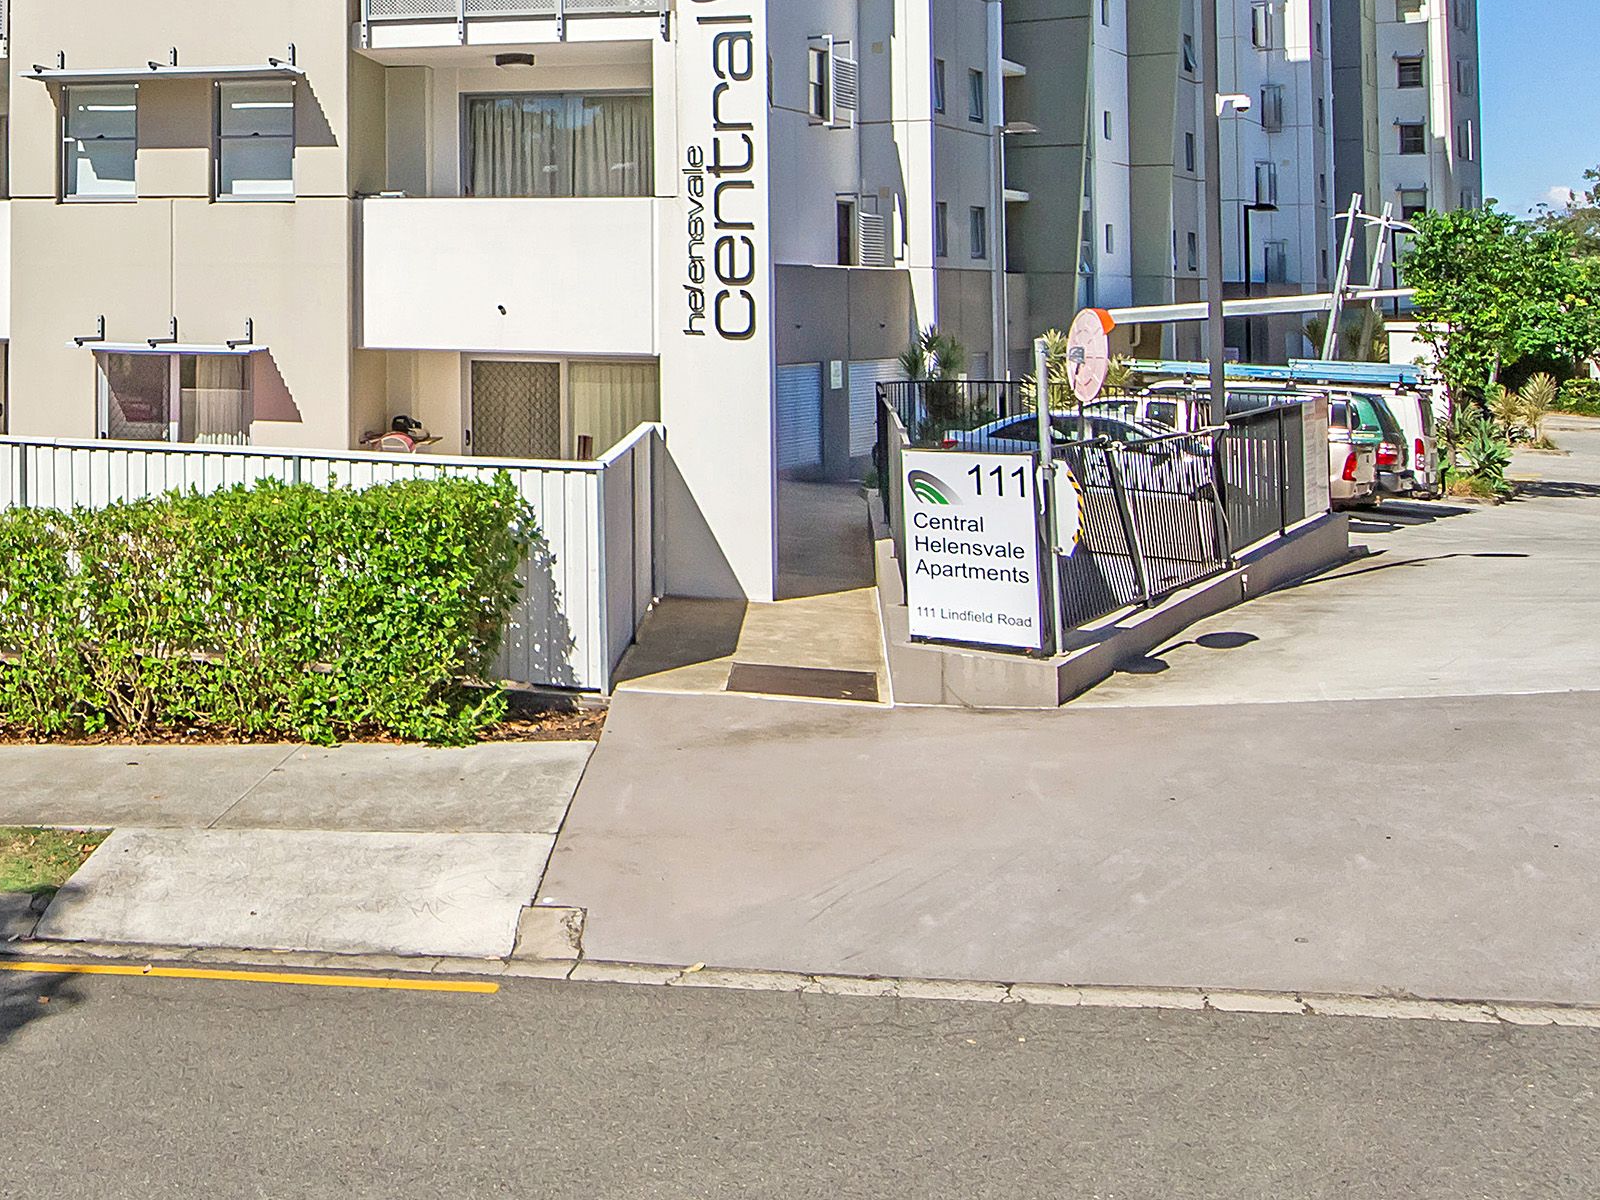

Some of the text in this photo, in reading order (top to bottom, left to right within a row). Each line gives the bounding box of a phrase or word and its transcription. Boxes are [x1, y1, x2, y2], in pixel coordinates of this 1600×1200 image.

[697, 14, 756, 341] central
[682, 144, 705, 337] helensvale
[968, 463, 1026, 498] 111
[913, 511, 984, 533] Central
[914, 535, 1025, 560] Helensvale
[915, 558, 1030, 584] Apartments
[916, 606, 1033, 628] 111 Lindfield Road
